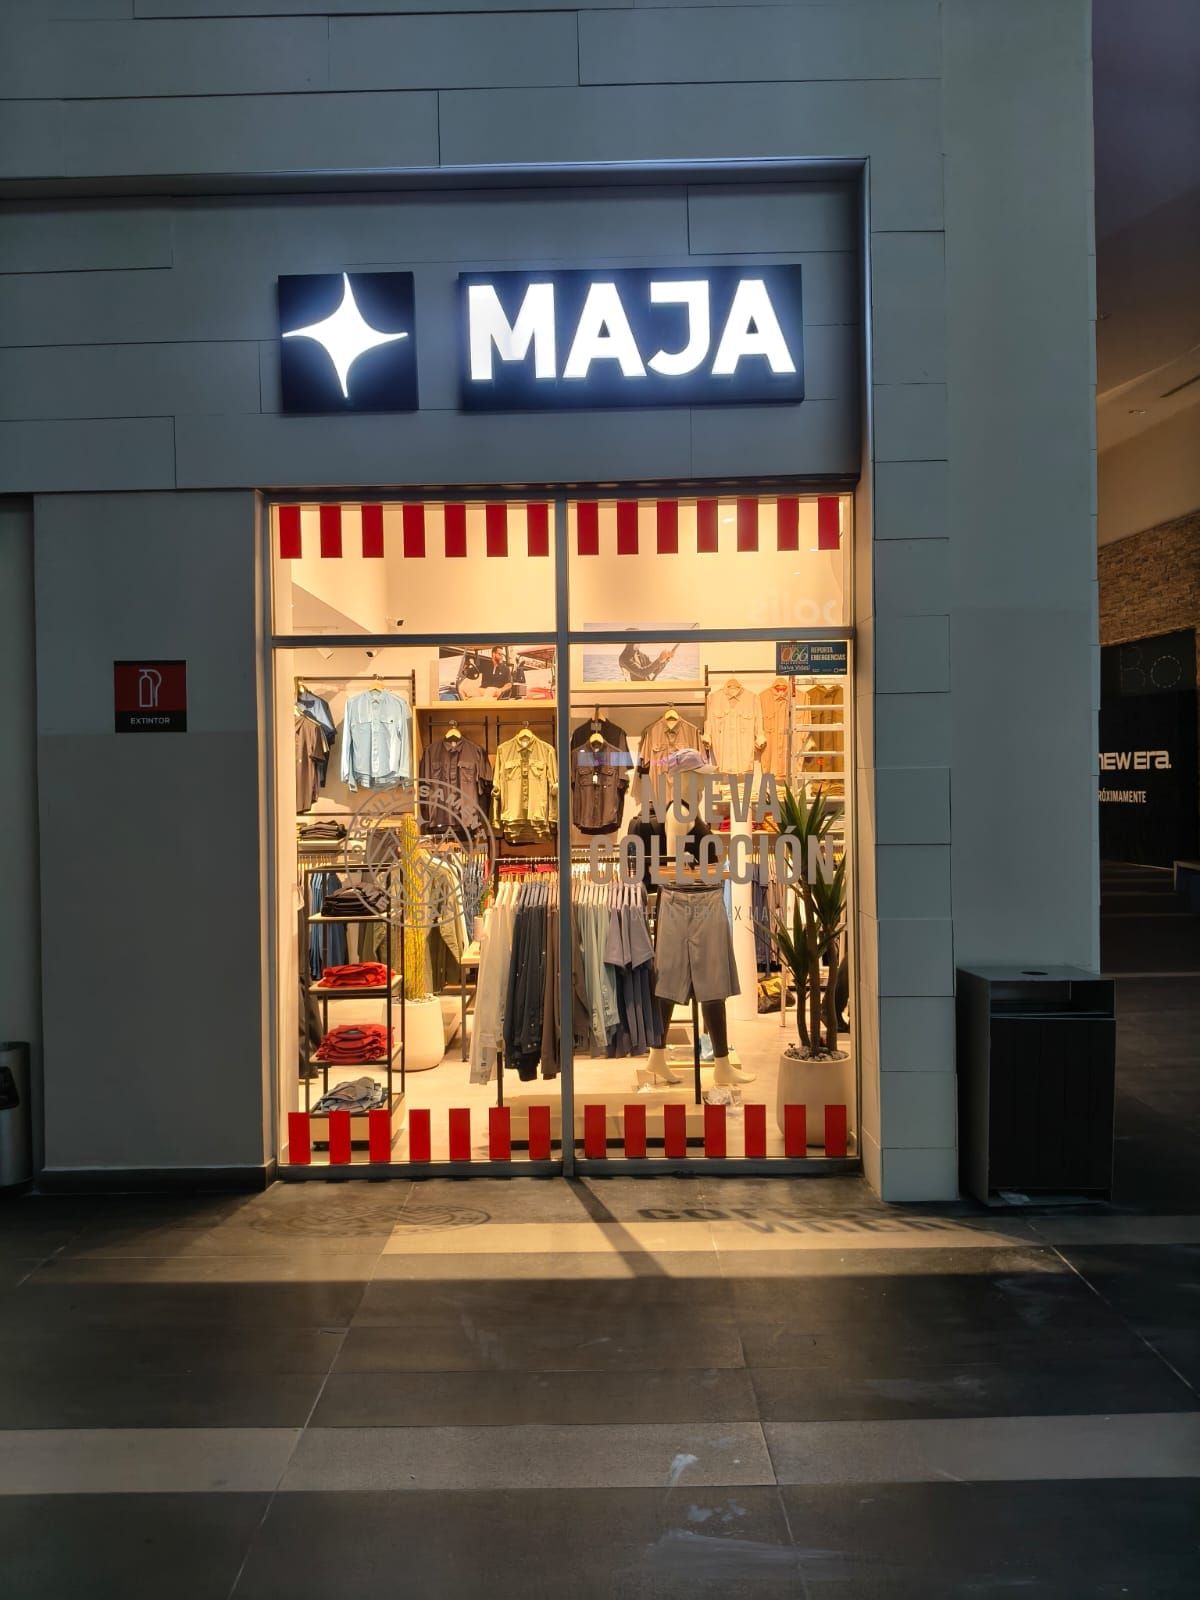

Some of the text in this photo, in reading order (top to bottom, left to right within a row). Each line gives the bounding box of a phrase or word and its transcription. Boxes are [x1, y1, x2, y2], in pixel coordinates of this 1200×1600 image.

[468, 280, 797, 380] MAJA
[811, 653, 846, 661] EMERGENCIAS
[130, 717, 171, 725] EXTINTOR
[640, 773, 782, 824] NUEVA
[1098, 787, 1147, 804] RÓXIMAMENTE
[589, 825, 834, 886] COLECCIÓN
[734, 905, 742, 921] X
